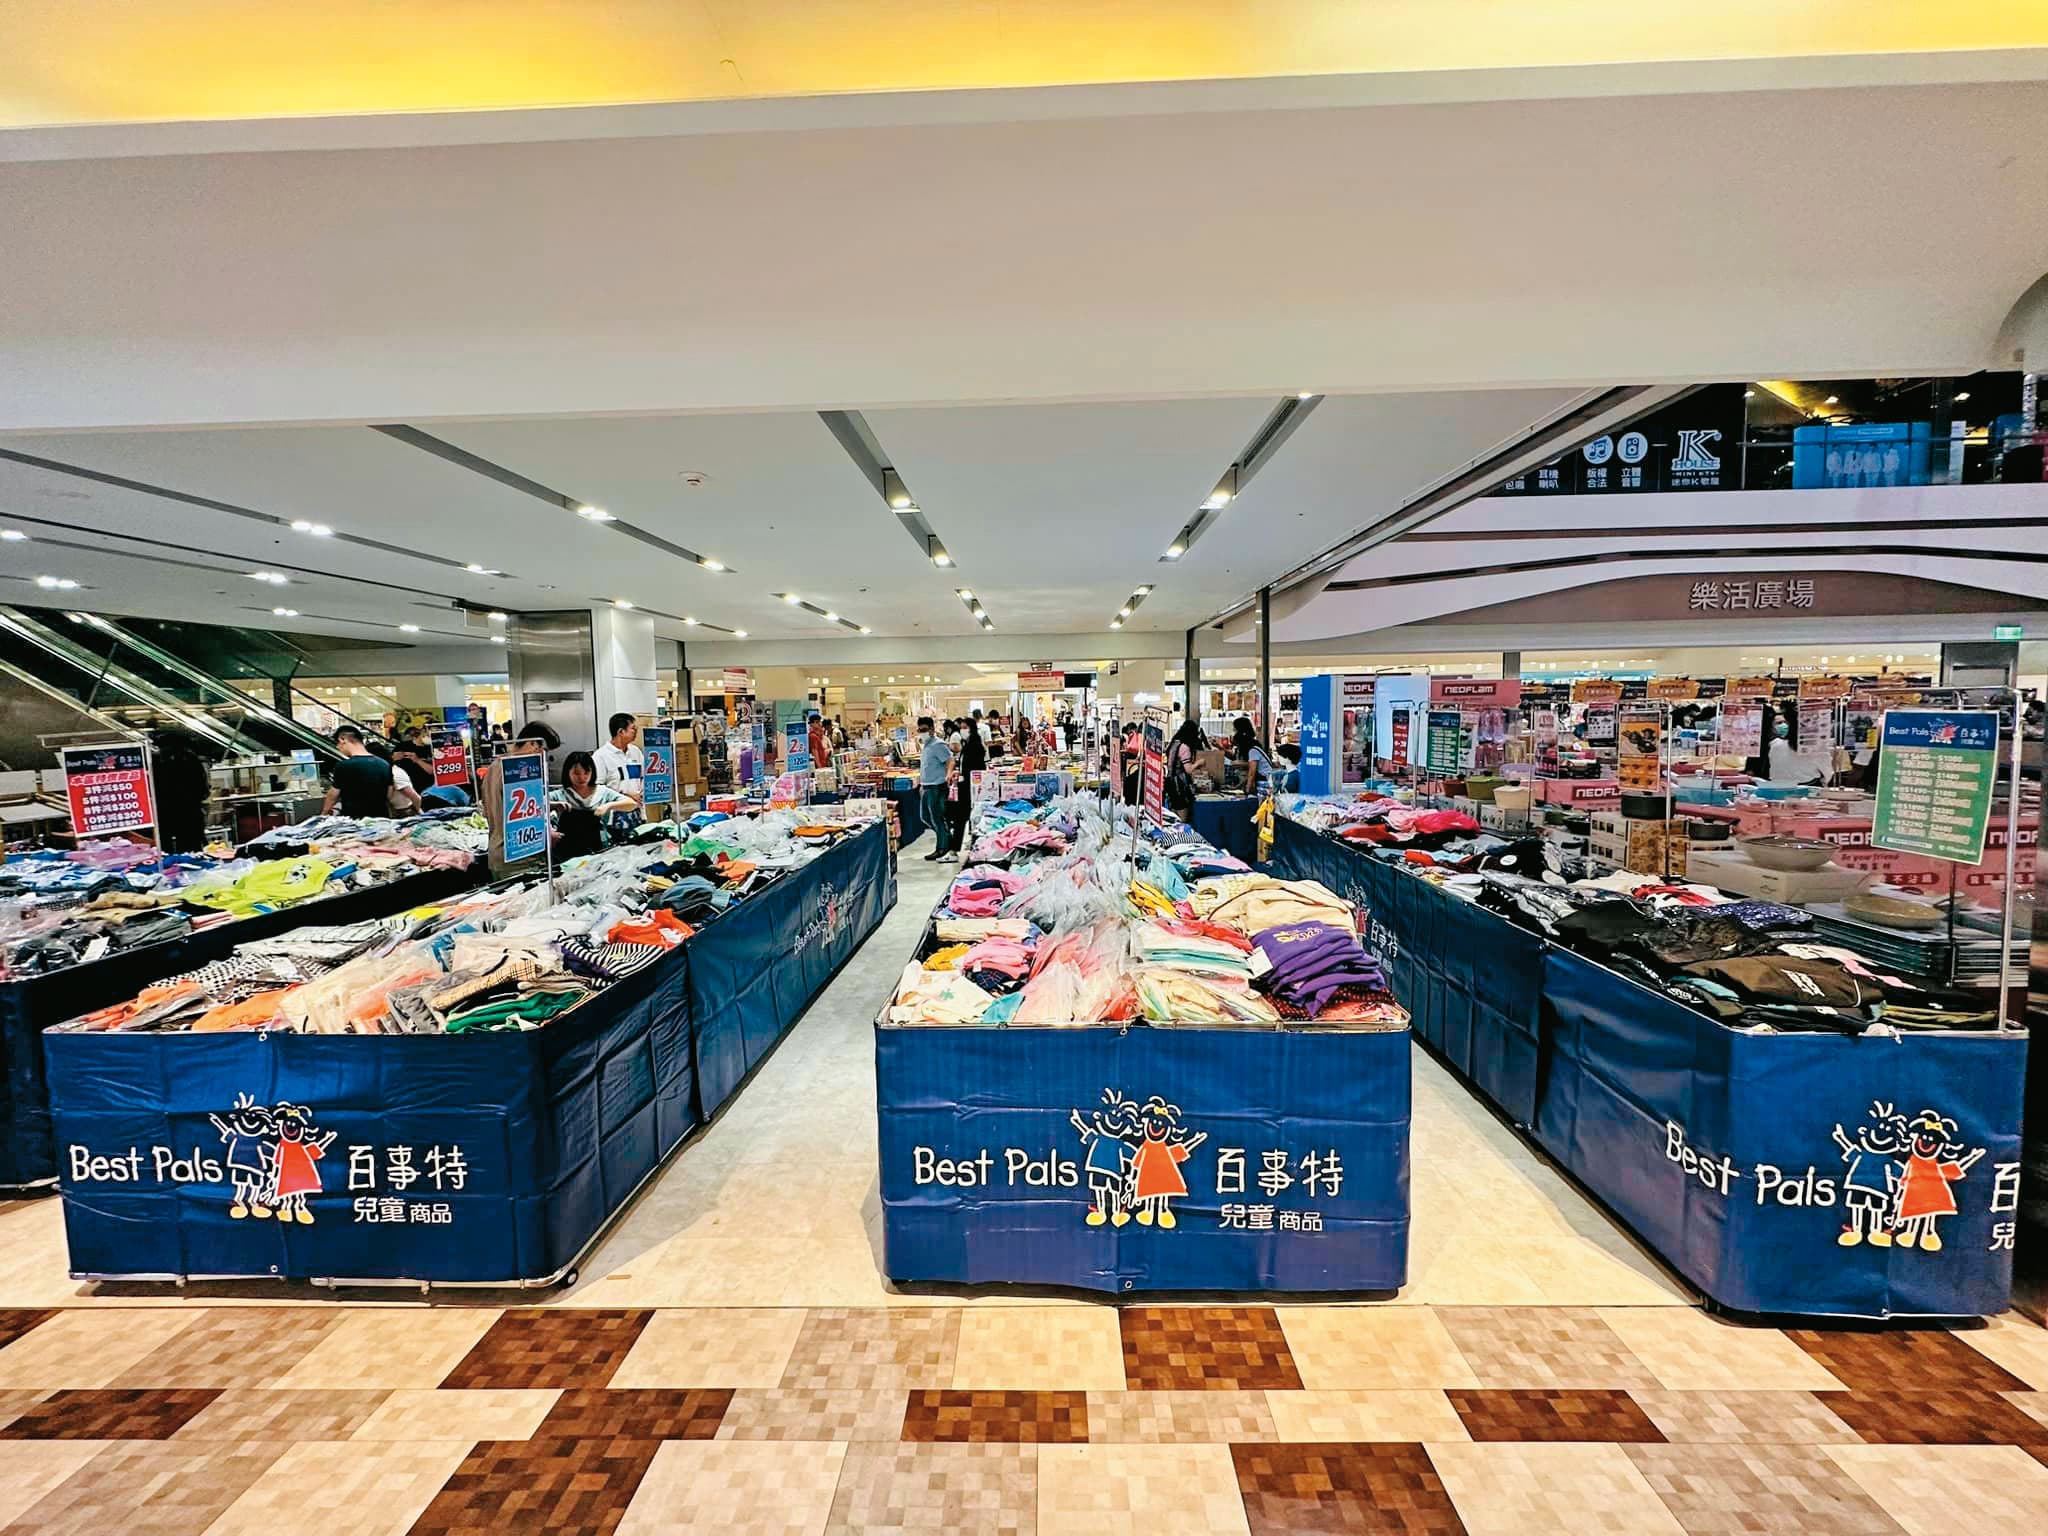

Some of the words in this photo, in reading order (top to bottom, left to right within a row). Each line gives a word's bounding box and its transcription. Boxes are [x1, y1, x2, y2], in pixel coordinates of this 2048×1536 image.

[1690, 579, 1815, 611] 樂活廣場
[436, 762, 462, 775] $299
[69, 1144, 144, 1182] Best
[151, 1146, 224, 1184] Pals
[347, 1144, 469, 1192] 百事特
[912, 1145, 995, 1187] Best
[1003, 1147, 1080, 1188] Pals
[1215, 1147, 1345, 1198] 百事特
[1665, 1119, 1741, 1197] Best
[1753, 1163, 1837, 1207] Pals
